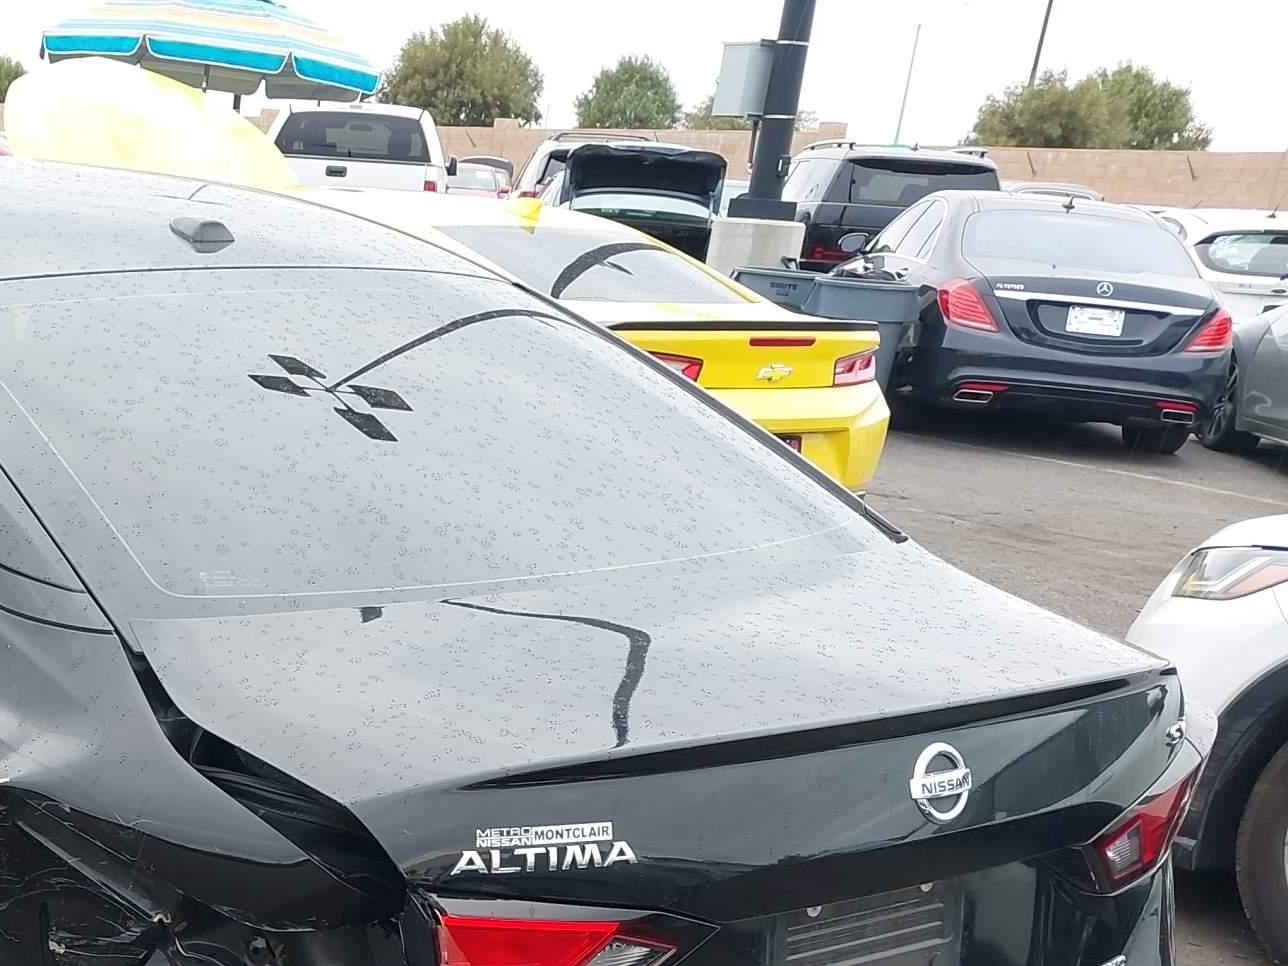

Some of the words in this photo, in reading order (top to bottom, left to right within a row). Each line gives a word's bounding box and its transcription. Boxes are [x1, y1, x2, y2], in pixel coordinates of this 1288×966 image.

[921, 771, 970, 795] NISSAN
[476, 826, 532, 838] METRO
[534, 824, 611, 841] MONTCLAIR
[476, 837, 532, 848] NISSAN
[450, 840, 639, 876] ALTIMA
